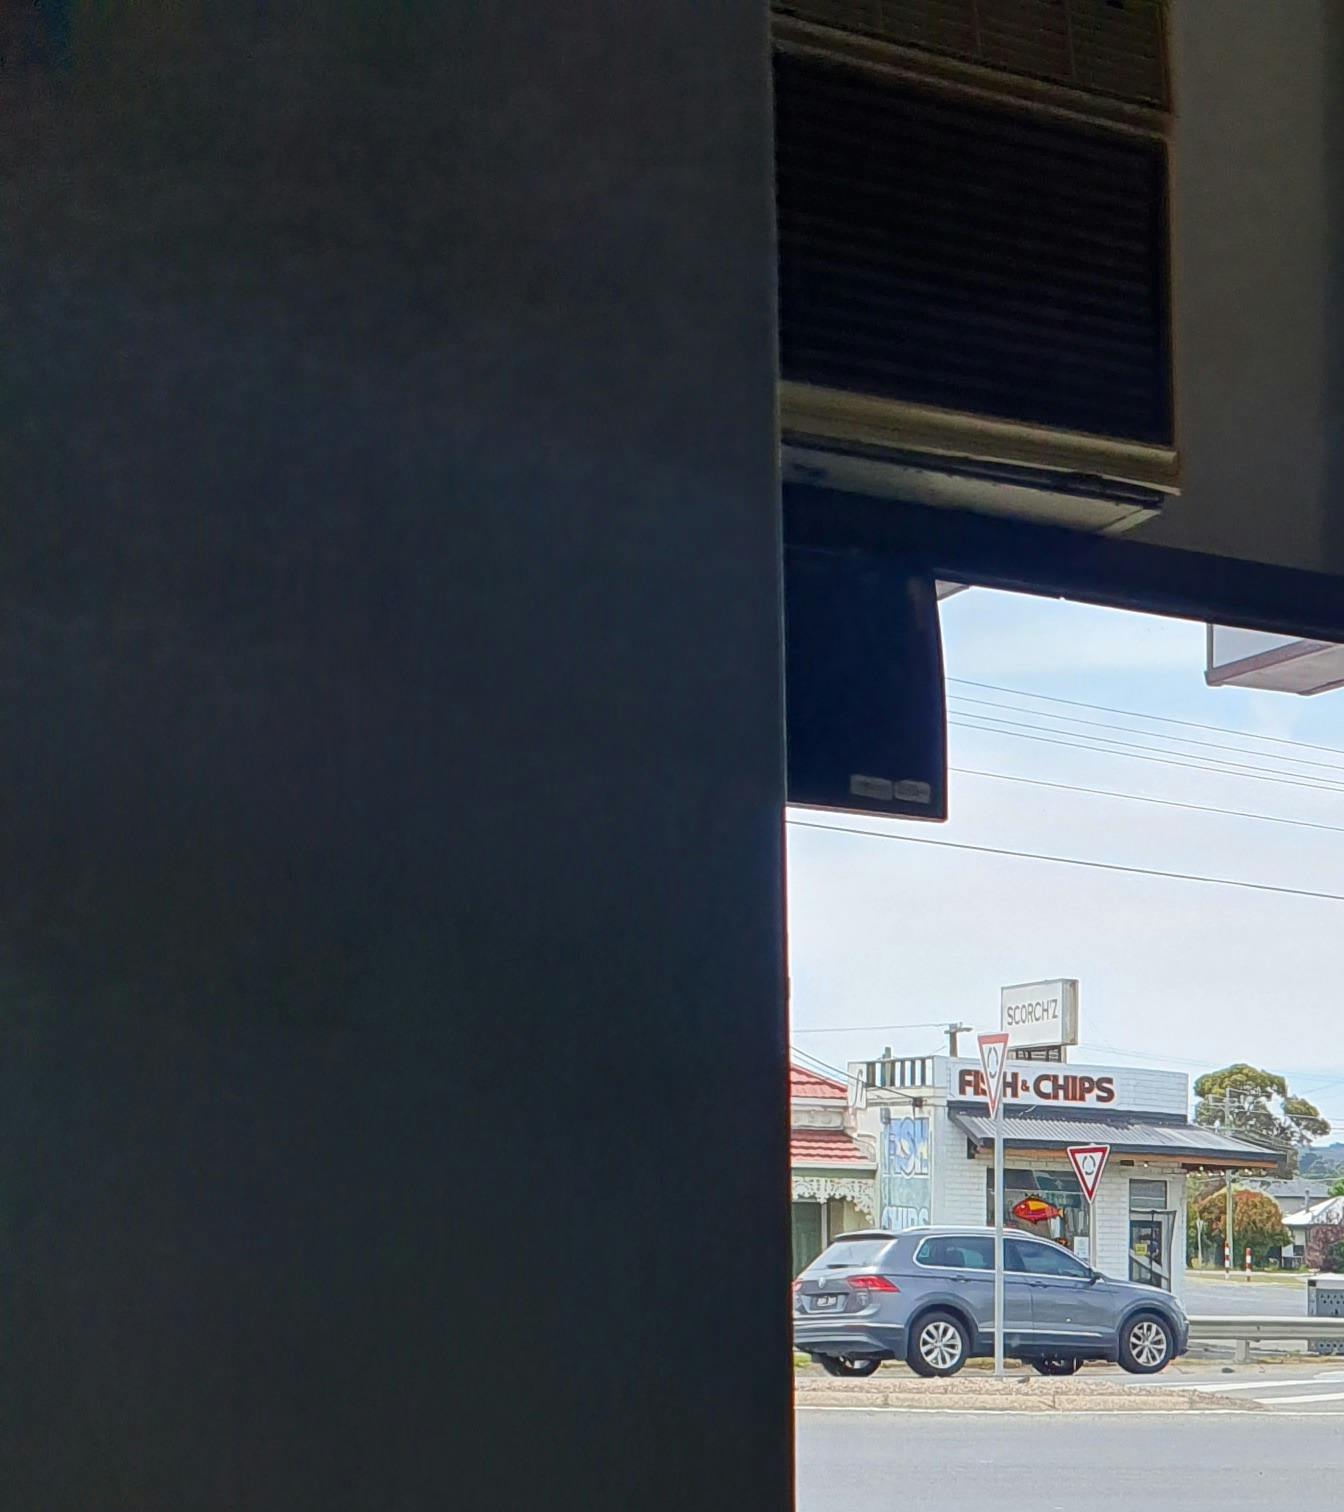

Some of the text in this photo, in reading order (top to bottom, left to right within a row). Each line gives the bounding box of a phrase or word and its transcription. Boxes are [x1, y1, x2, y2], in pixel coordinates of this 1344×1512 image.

[1006, 998, 1059, 1027] SCORCH'Z
[1021, 1079, 1031, 1093] &
[1032, 1073, 1116, 1104] CHIPS
